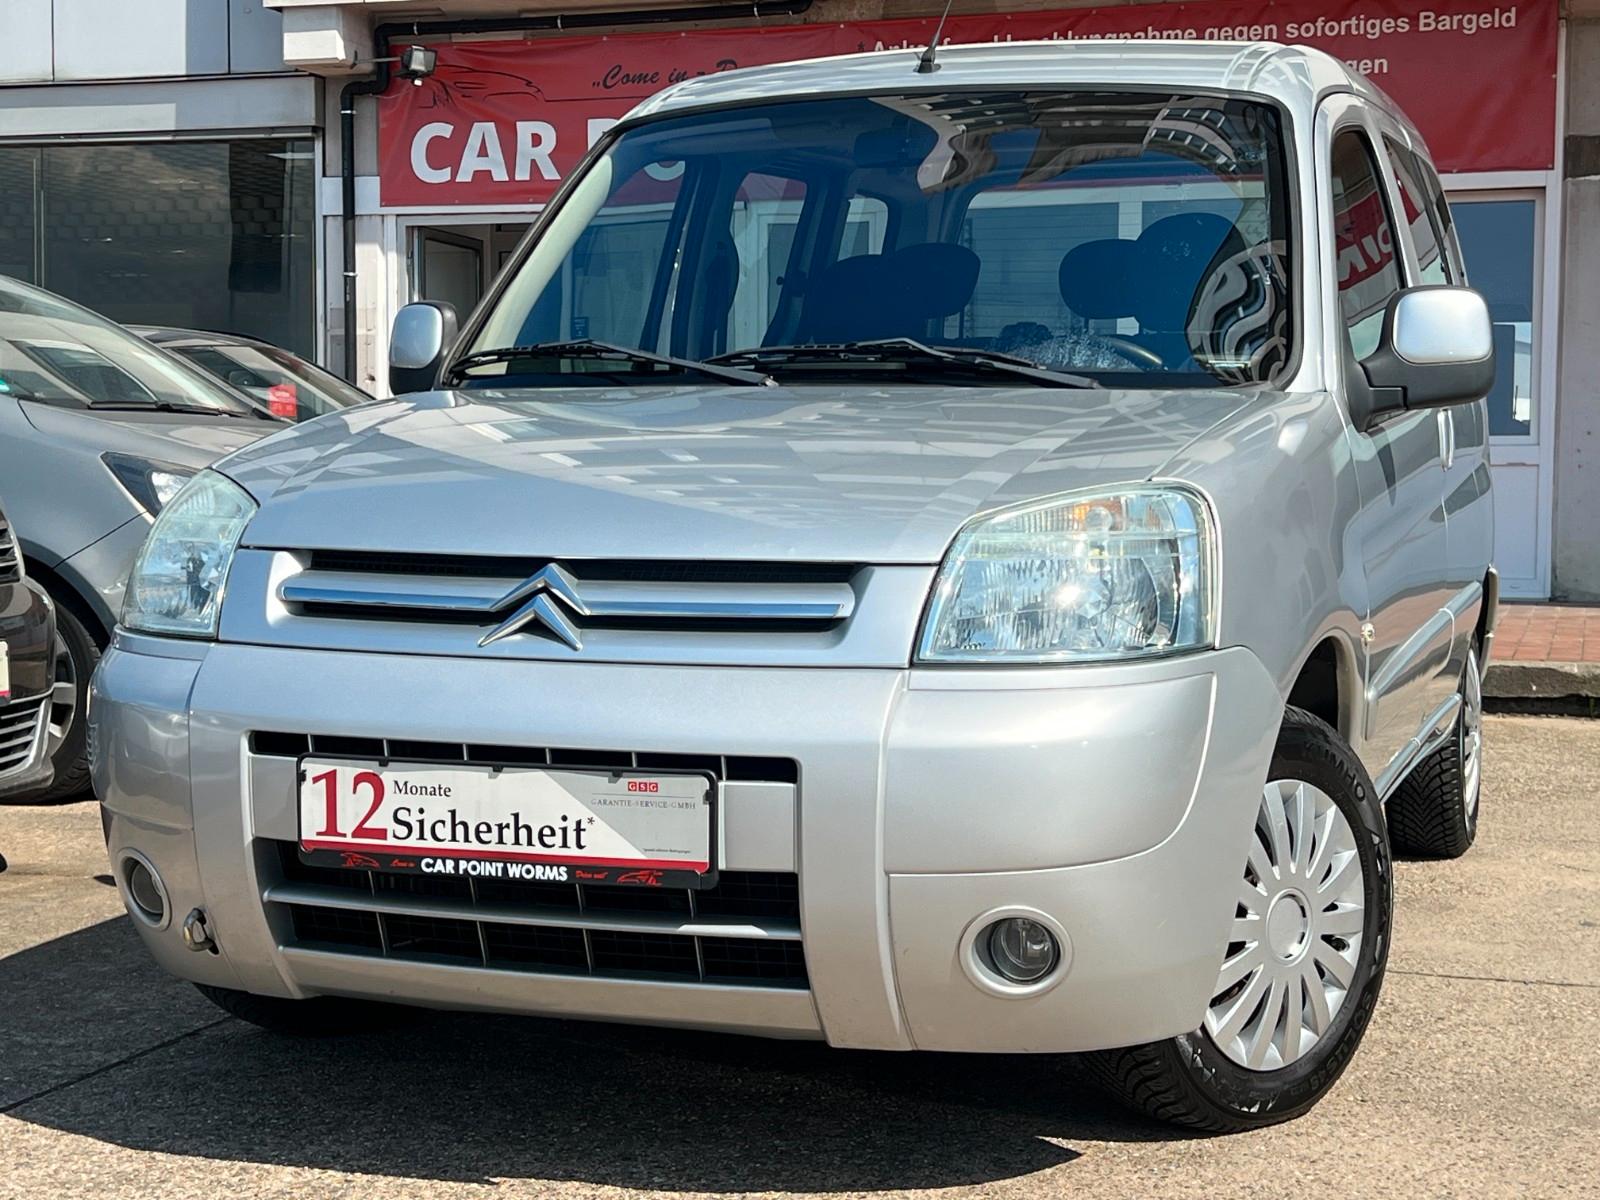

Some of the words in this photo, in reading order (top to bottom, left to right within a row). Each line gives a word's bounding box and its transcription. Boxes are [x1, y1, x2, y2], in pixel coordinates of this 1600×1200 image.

[1204, 22, 1278, 41] gegen
[1285, 14, 1410, 39] sofortiges
[1418, 6, 1517, 35] Bargeld
[668, 67, 689, 83] in
[409, 120, 562, 185] CAR
[392, 780, 452, 798] Monate
[628, 781, 658, 792] GSG
[311, 768, 388, 841] 12
[420, 857, 455, 874] CAR
[458, 859, 504, 877] POINT
[506, 862, 569, 882] WORMS
